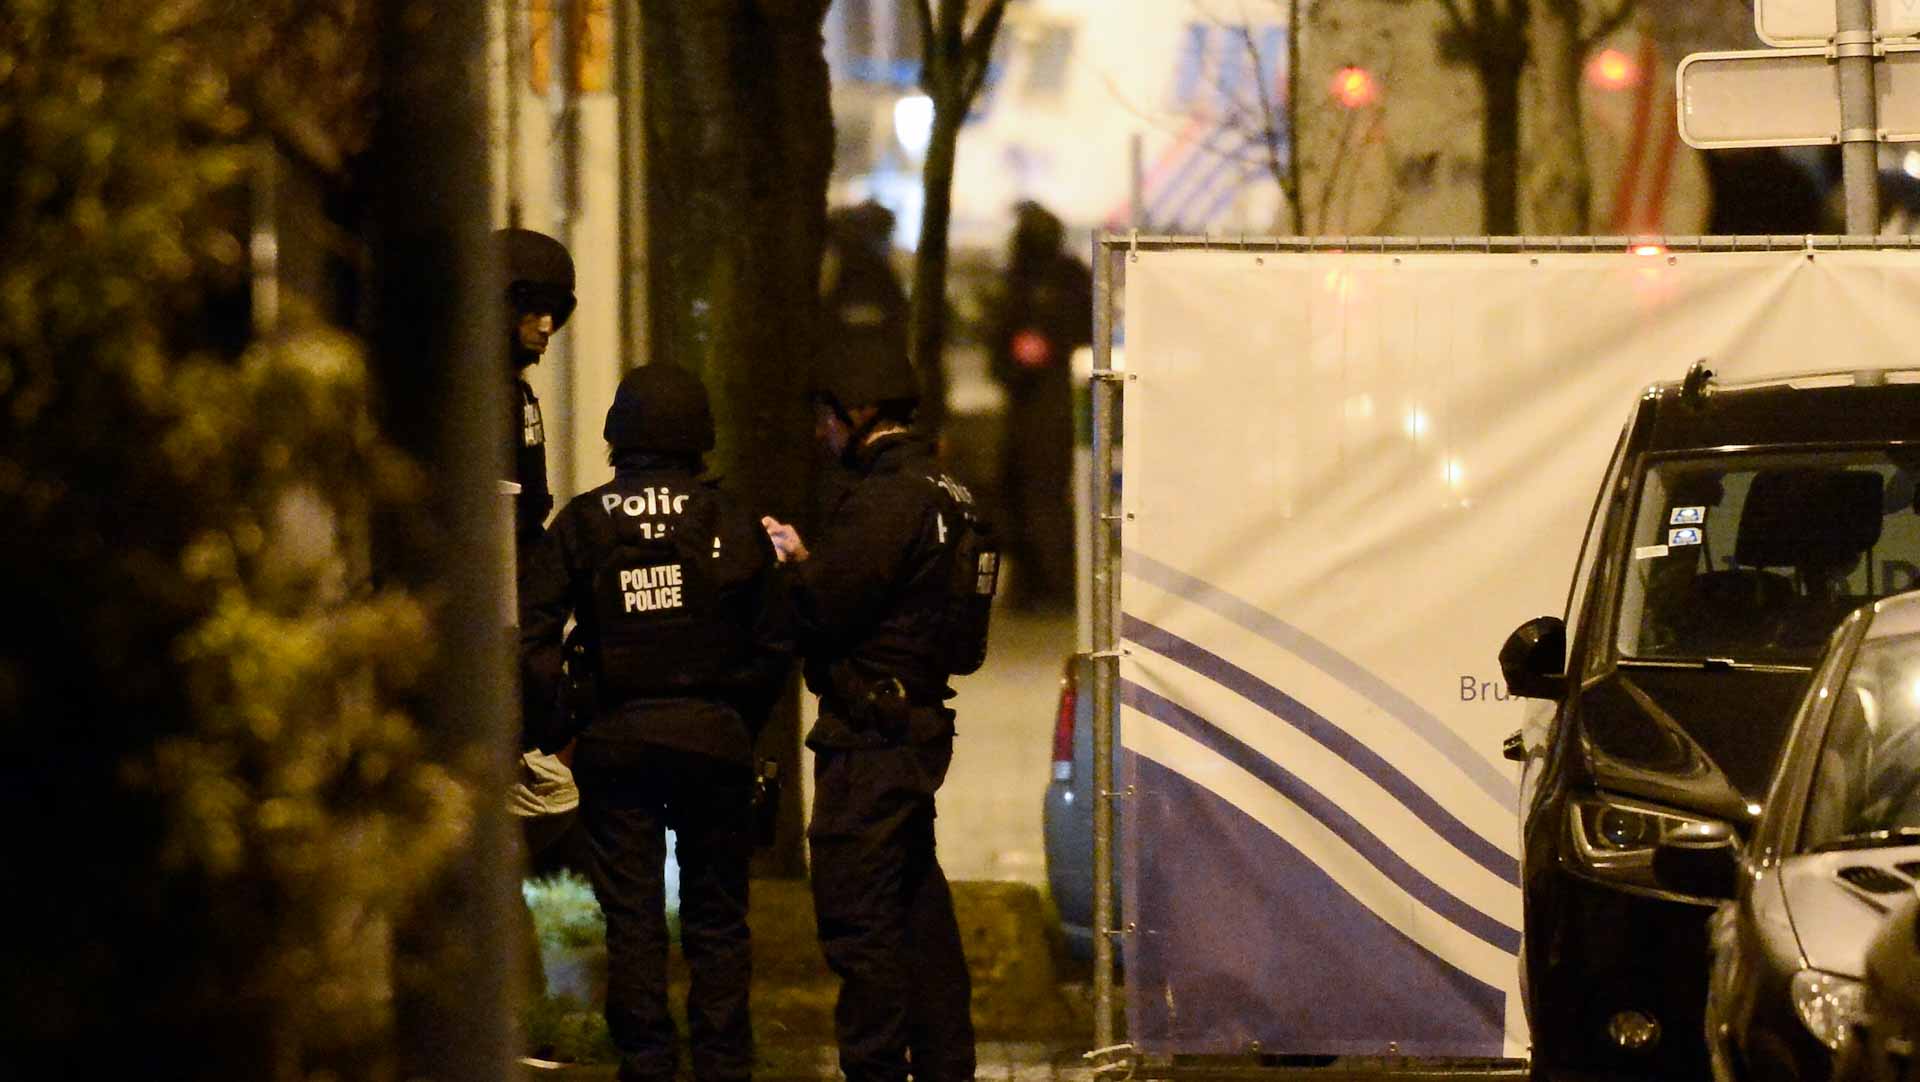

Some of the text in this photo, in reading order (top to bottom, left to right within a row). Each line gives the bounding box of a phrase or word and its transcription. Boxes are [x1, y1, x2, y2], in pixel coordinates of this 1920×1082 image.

[620, 564, 683, 592] POLITIE
[624, 586, 683, 613] POLICE
[1460, 675, 1519, 702] Bru
